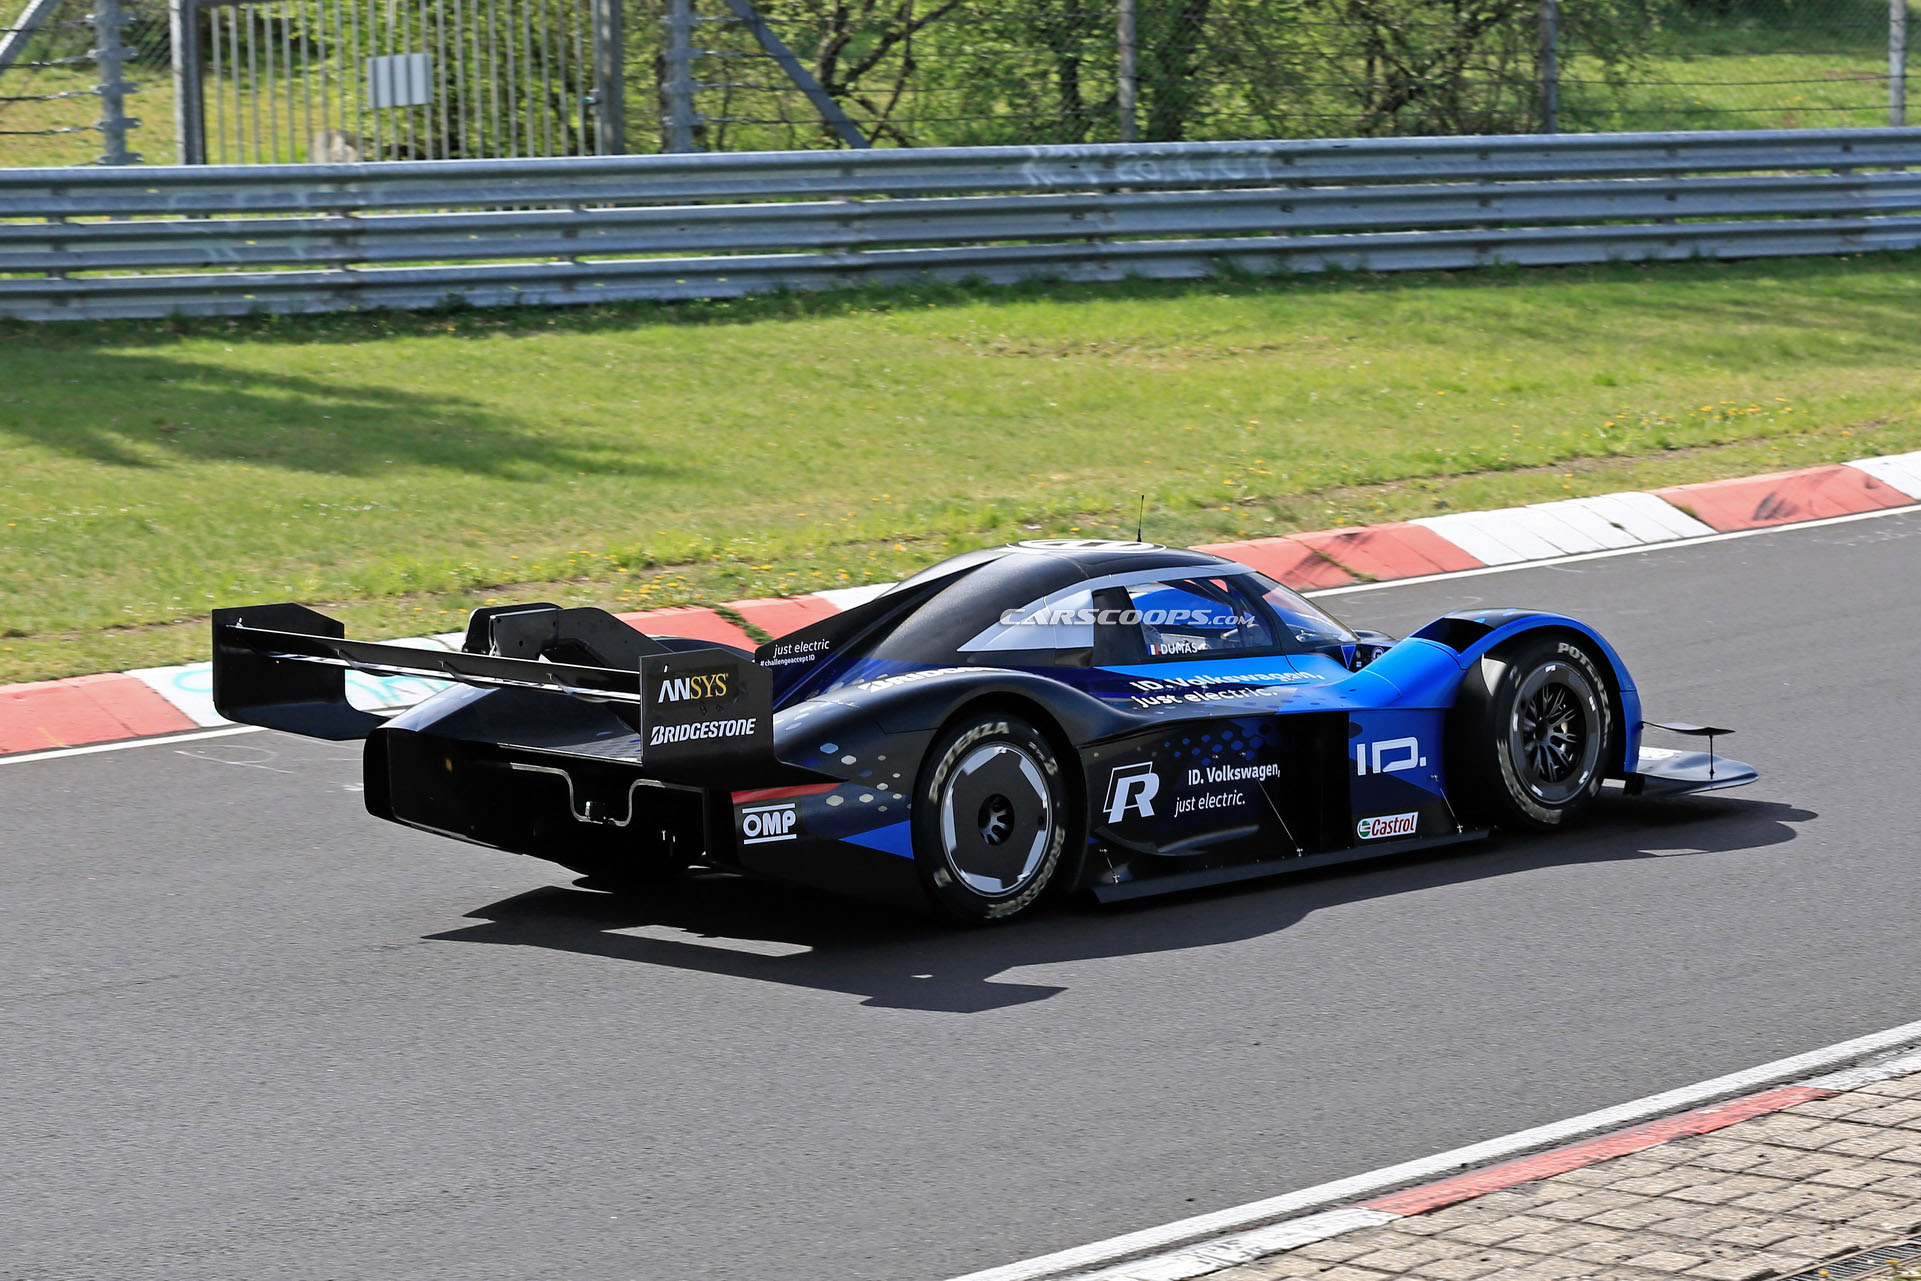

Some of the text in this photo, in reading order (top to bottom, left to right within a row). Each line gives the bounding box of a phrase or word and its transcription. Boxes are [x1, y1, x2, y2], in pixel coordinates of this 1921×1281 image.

[773, 638, 830, 659] just electric
[1160, 641, 1198, 655] DUMAS
[657, 672, 728, 704] ANSYS
[1129, 670, 1326, 692] ID. Volkswagen,
[1130, 686, 1278, 709] just electric.
[650, 718, 757, 746] BRIDGESTONE
[1357, 736, 1427, 776] ID.
[1188, 762, 1281, 785] ID. Volkswagen,
[1108, 772, 1160, 824] R
[1173, 789, 1246, 818] just electric.
[742, 809, 797, 837] OMP
[1371, 815, 1416, 836] Castrol
